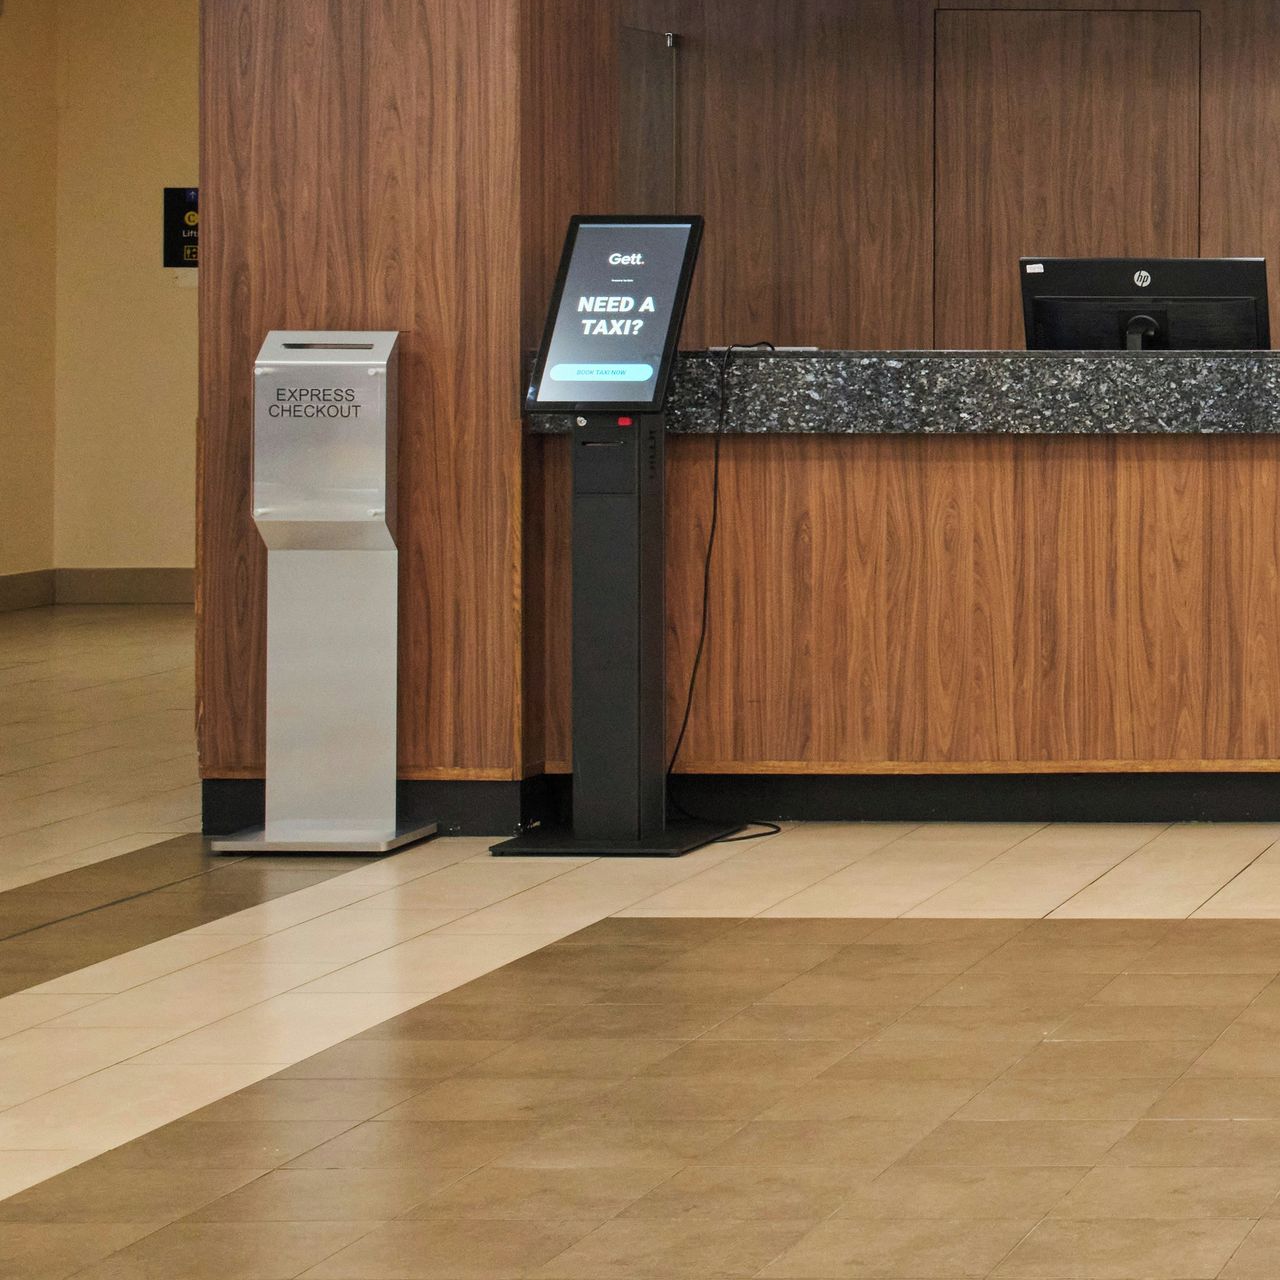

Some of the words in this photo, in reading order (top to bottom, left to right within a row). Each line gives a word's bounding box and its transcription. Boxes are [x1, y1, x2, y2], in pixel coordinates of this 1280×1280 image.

[608, 253, 645, 266] Gett.
[1134, 270, 1151, 288] hp
[577, 296, 635, 313] NEED
[639, 296, 656, 313] A
[581, 320, 644, 336] TAXI?
[276, 388, 356, 402] EXPRESS
[268, 404, 362, 418] CHECKOUT
